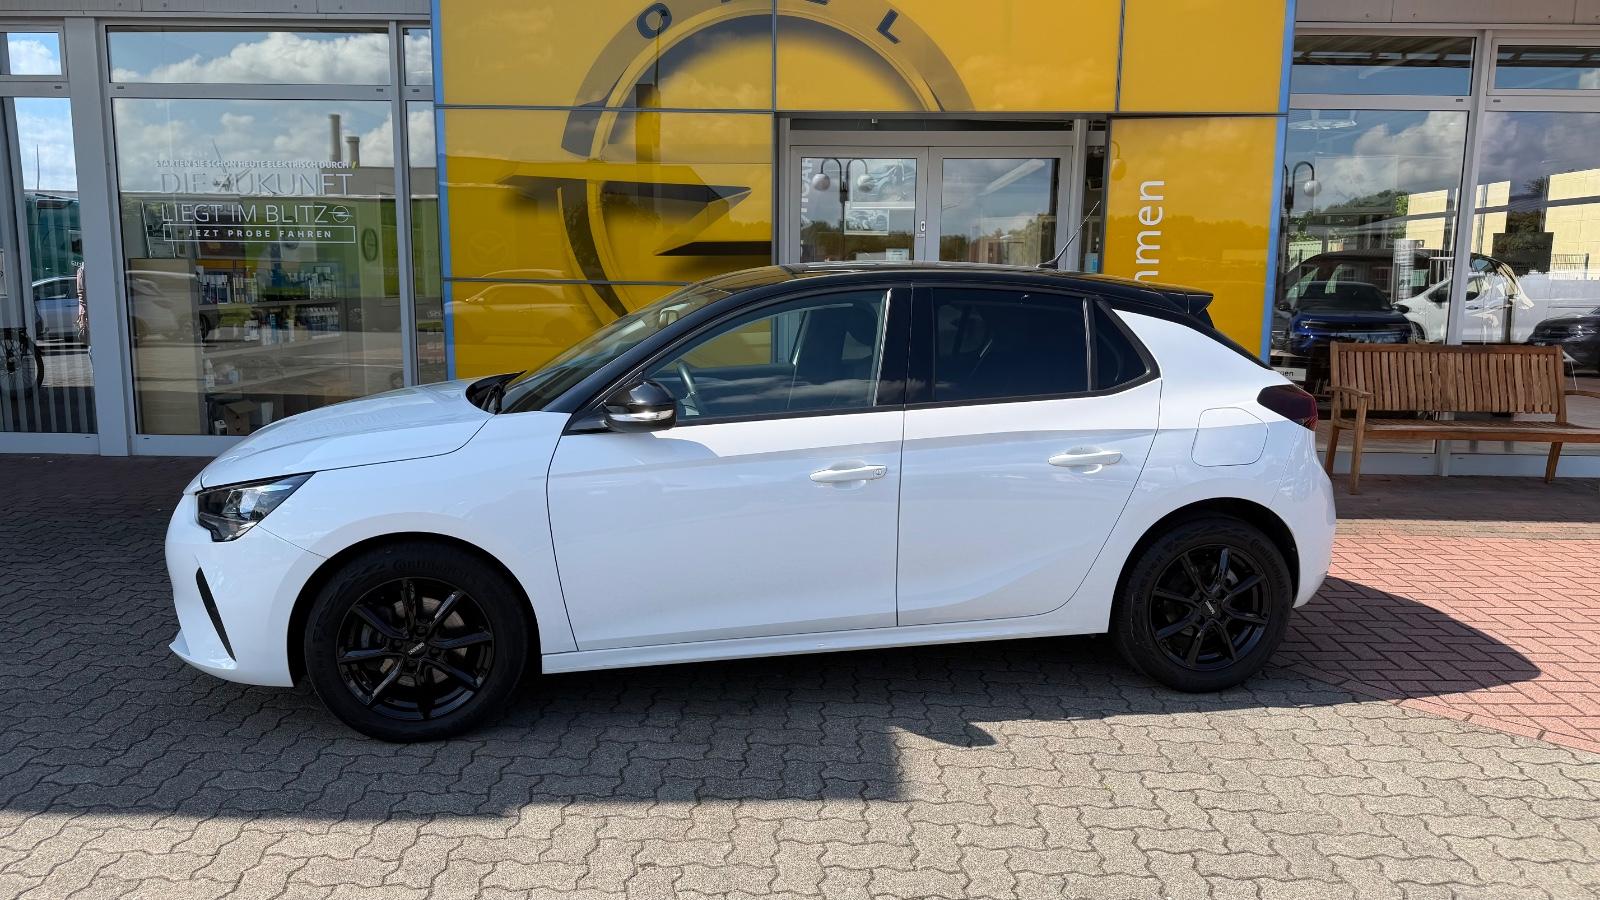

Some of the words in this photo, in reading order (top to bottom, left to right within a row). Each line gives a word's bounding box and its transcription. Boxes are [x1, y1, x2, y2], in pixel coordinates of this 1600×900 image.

[636, 0, 901, 46] OL
[239, 160, 266, 168] HEUTE
[267, 160, 318, 169] ELEKTRISCH
[320, 161, 349, 169] DURCH
[161, 172, 207, 194] DIE
[161, 204, 223, 222] LIEGT
[231, 204, 257, 223] IM
[265, 204, 329, 223] BLITZ
[188, 229, 219, 237] JEZT
[227, 229, 271, 237] PROBE
[279, 230, 332, 238] FAHREN
